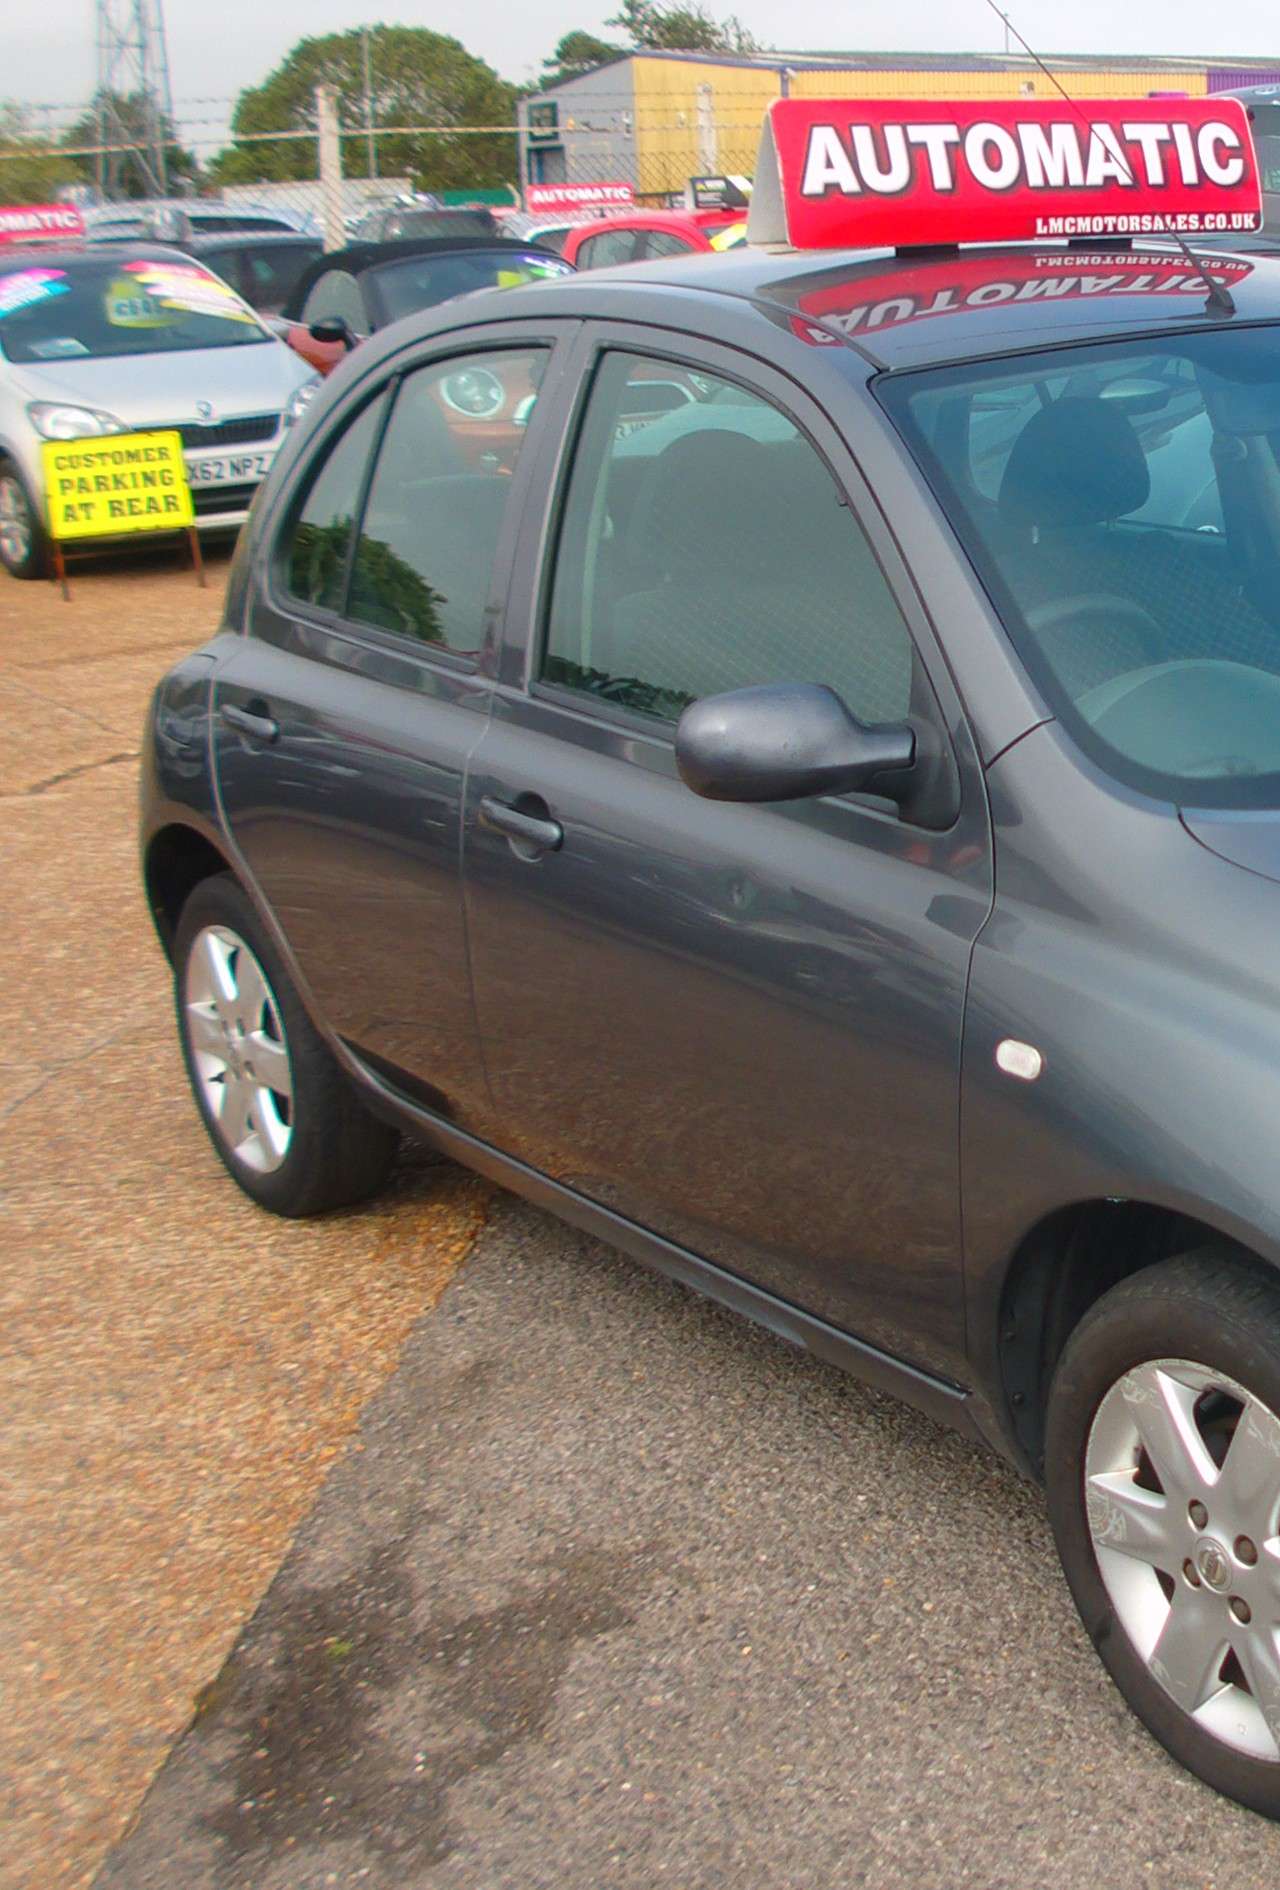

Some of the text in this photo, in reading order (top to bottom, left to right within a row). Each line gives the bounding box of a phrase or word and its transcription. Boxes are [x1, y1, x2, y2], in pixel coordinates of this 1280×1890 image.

[802, 121, 1245, 196] AUTOMATIC
[532, 186, 631, 204] AUTOMATIC
[1035, 212, 1256, 235] LMCMOTORSALES.CO.UK
[54, 446, 172, 471] CUSTOMER
[59, 468, 175, 496] PARKING
[63, 494, 181, 523] AT REAR
